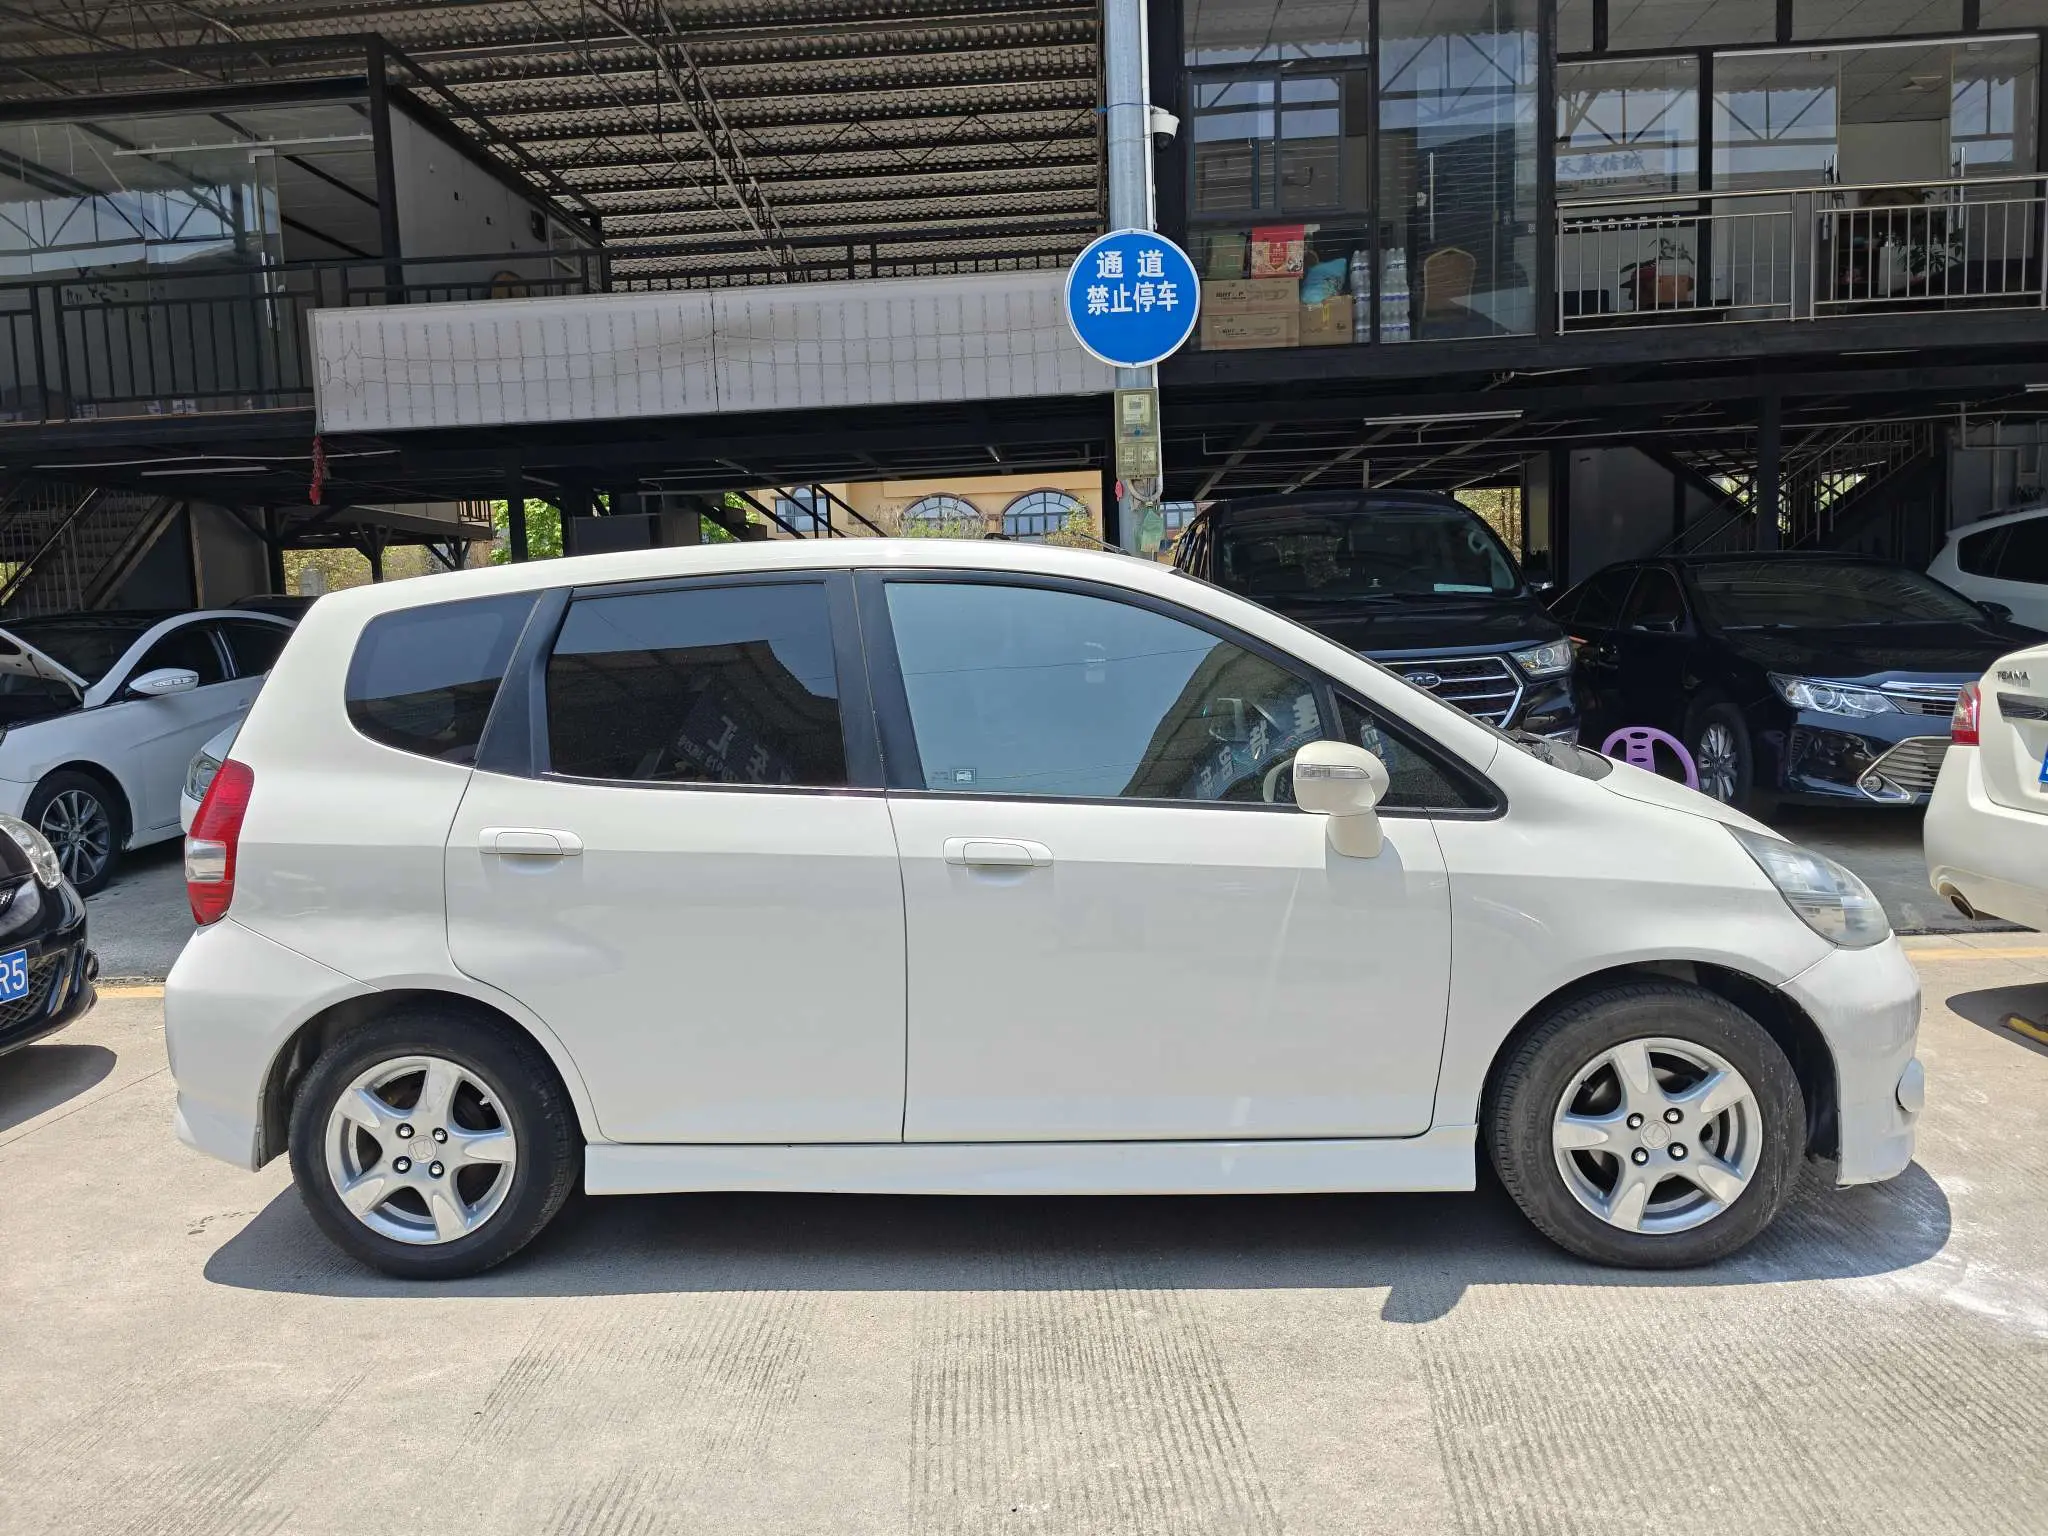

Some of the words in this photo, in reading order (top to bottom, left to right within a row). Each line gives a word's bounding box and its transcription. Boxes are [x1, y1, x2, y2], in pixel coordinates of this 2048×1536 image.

[1096, 250, 1165, 280] 通道
[1087, 280, 1179, 316] 禁止停车
